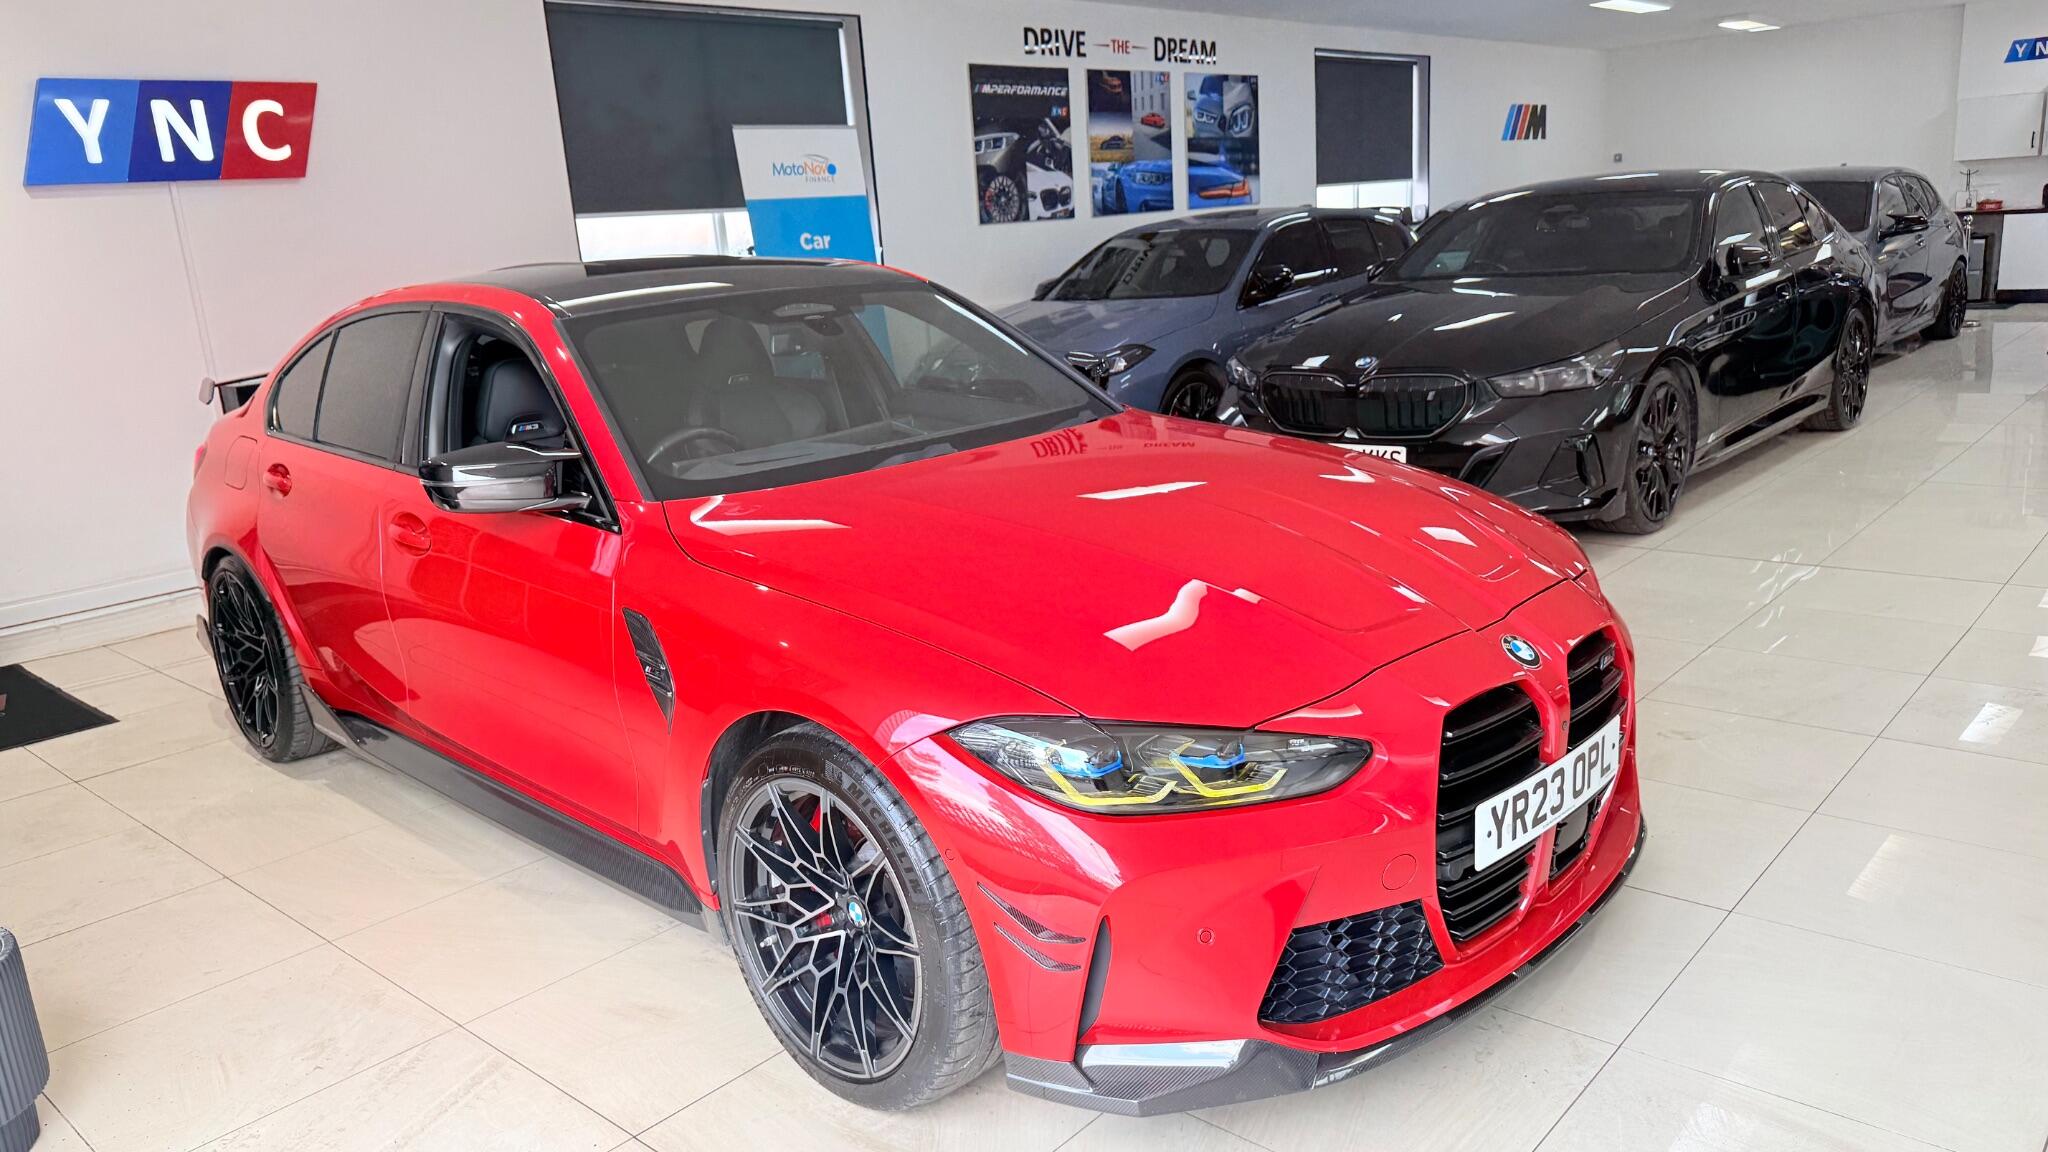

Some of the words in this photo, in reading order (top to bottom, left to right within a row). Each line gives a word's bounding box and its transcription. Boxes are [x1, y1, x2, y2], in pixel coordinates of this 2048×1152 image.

[1023, 27, 1087, 57] DRIVE
[1110, 39, 1131, 54] THE
[1154, 37, 1217, 65] DREAM
[54, 99, 291, 163] YNC
[800, 233, 831, 250] Car
[1491, 767, 1565, 849] YR23
[1572, 734, 1610, 799] OPL
[847, 782, 921, 894] MICHELIN
